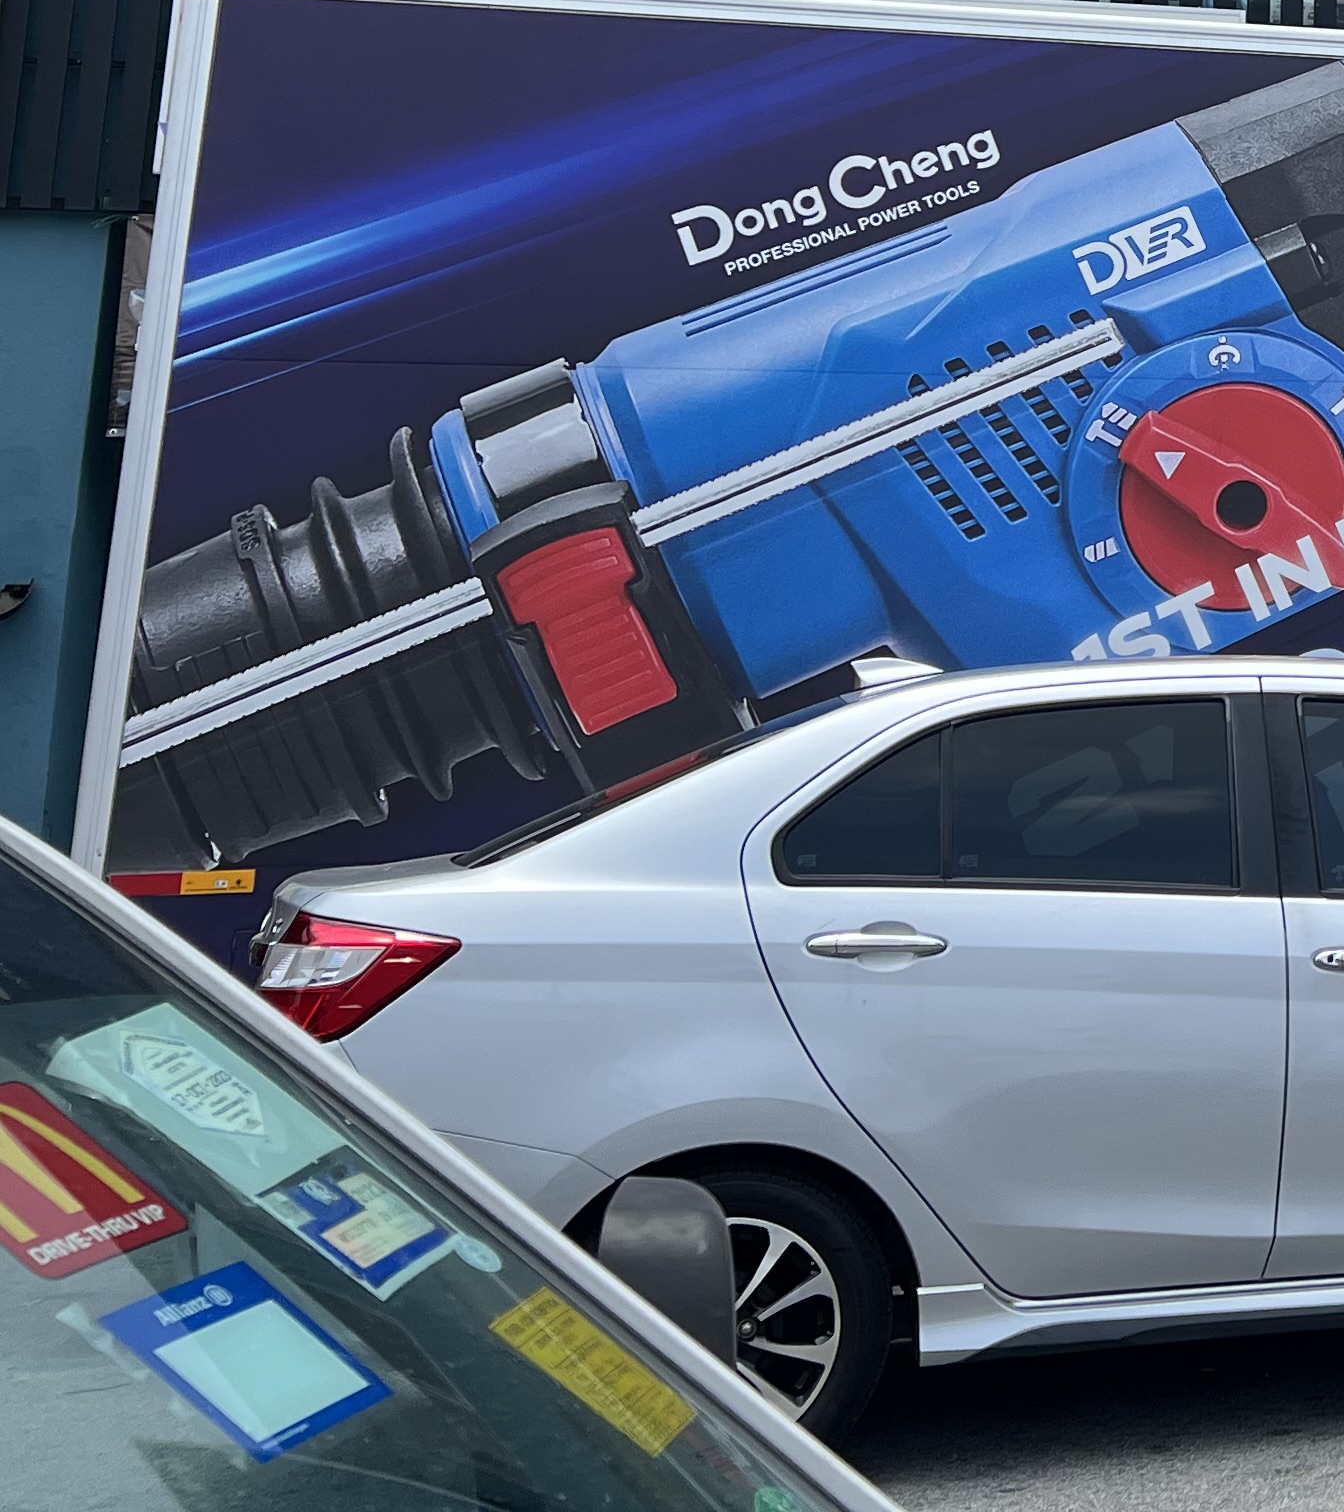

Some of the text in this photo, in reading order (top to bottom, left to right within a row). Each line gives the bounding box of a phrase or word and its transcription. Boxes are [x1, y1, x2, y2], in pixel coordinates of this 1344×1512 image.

[725, 180, 980, 276] PROFESSIONAL POWER TOOLS
[1235, 535, 1332, 622] IN
[27, 1204, 166, 1266] DRIVE-THRU VIP
[154, 1296, 212, 1326] Allianz
